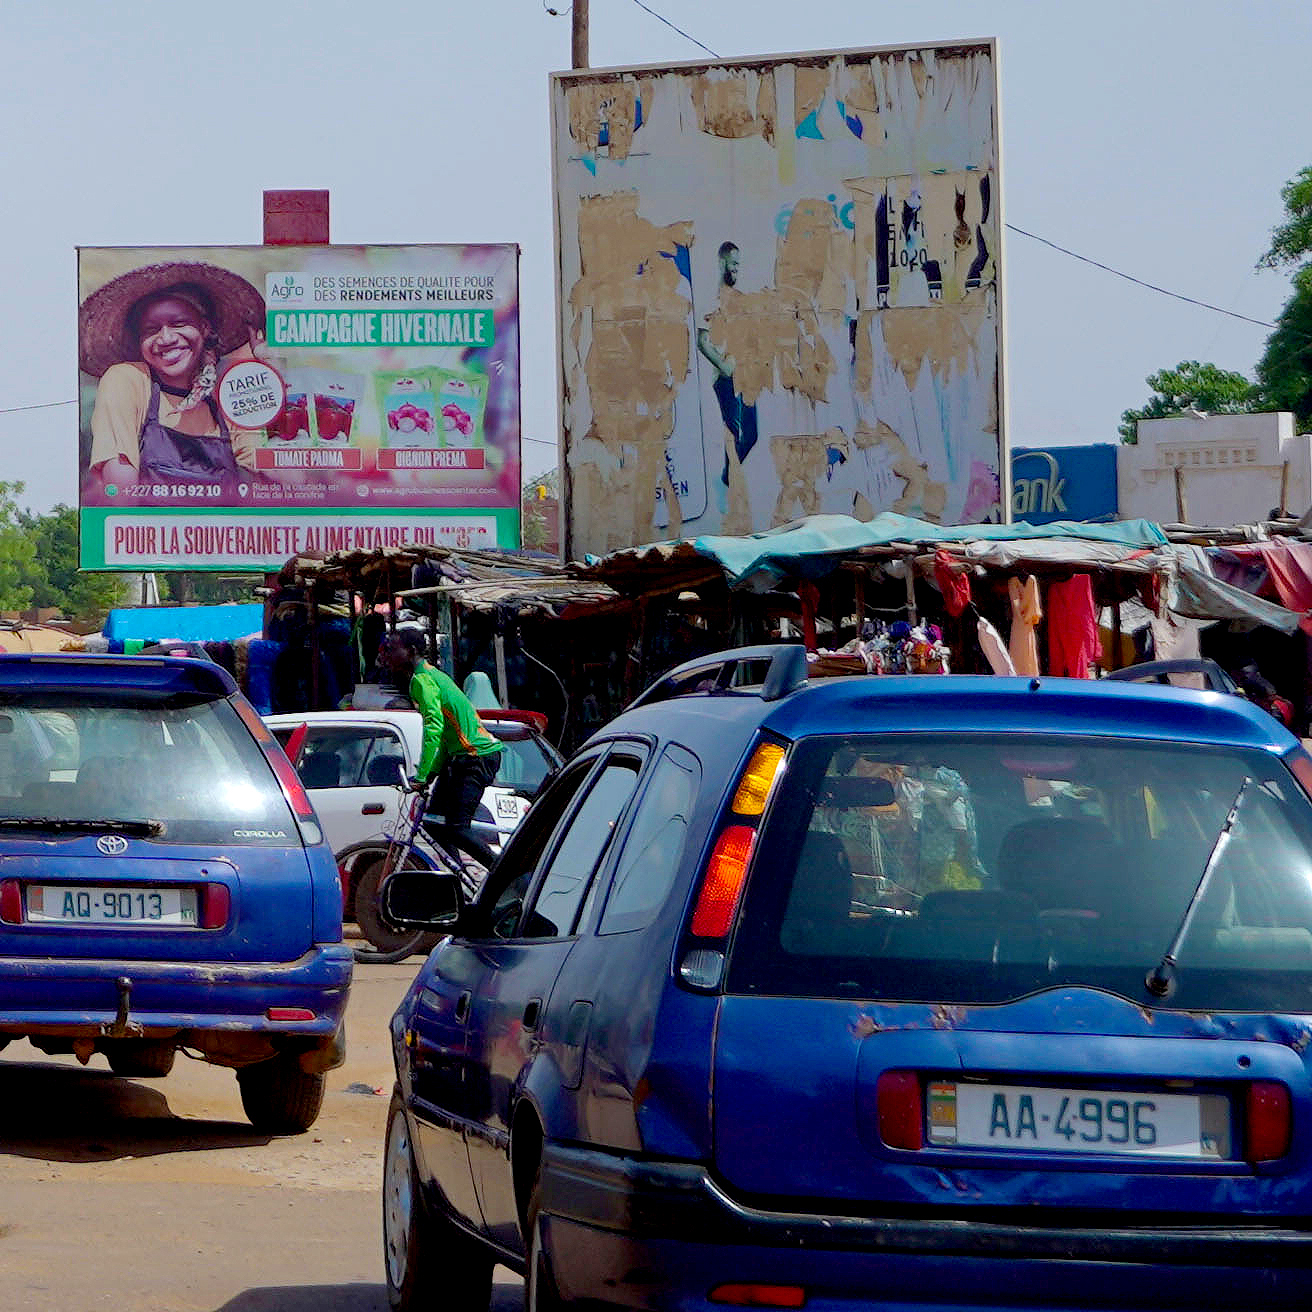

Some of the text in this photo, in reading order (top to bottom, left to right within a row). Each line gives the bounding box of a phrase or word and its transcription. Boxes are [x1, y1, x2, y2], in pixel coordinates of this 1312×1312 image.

[314, 276, 335, 288] DES
[338, 276, 394, 288] SEMENCES
[399, 276, 413, 288] DE
[464, 276, 495, 288] POUR
[314, 290, 336, 301] DES
[340, 289, 423, 301] RENDEMENTS
[427, 289, 494, 301] MEILLEURS
[274, 313, 485, 343] CAMPAGNE HIVERNALE
[226, 372, 268, 392] TARIF
[260, 391, 275, 403] DE
[114, 526, 157, 555] POUR
[160, 526, 180, 555] LA
[183, 525, 300, 555] SOUVERAINETE
[233, 830, 286, 838] COROLLA
